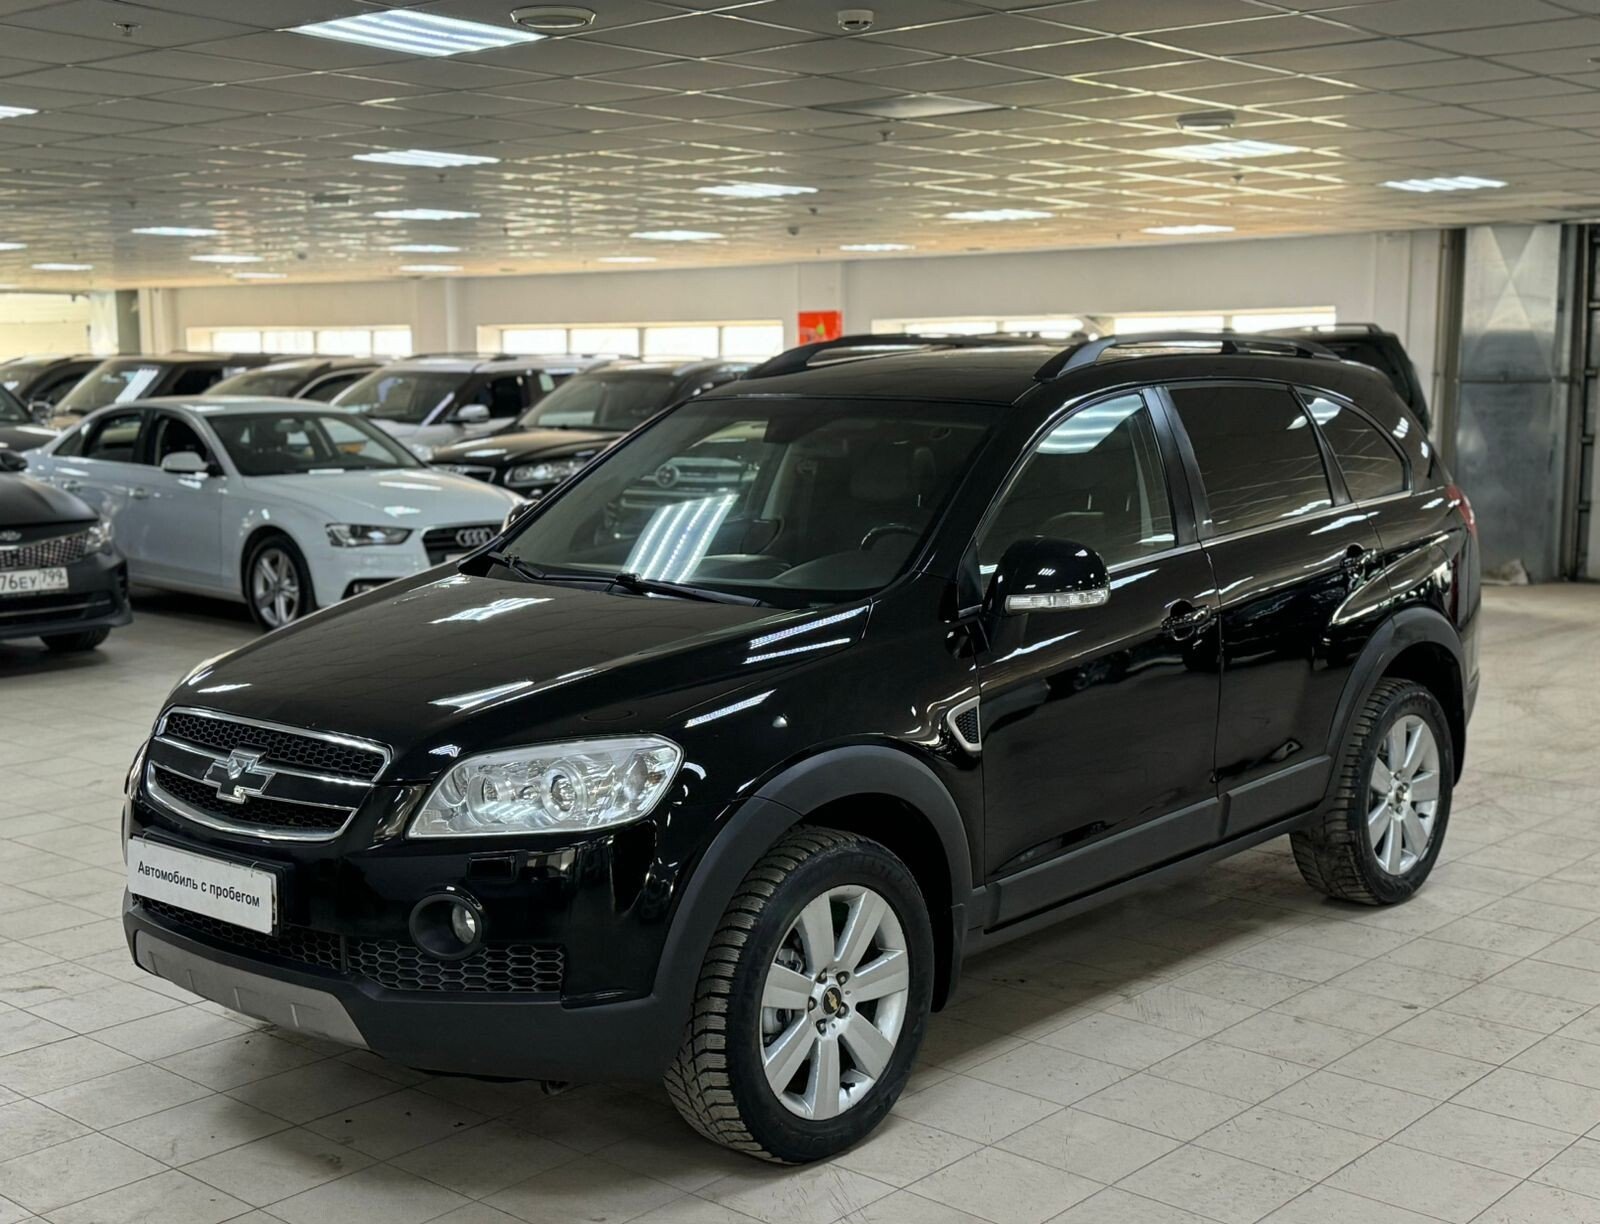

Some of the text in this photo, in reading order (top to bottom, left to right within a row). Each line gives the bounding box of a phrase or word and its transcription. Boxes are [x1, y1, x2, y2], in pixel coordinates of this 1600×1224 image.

[138, 860, 260, 908] Автомобиль с пробегом
